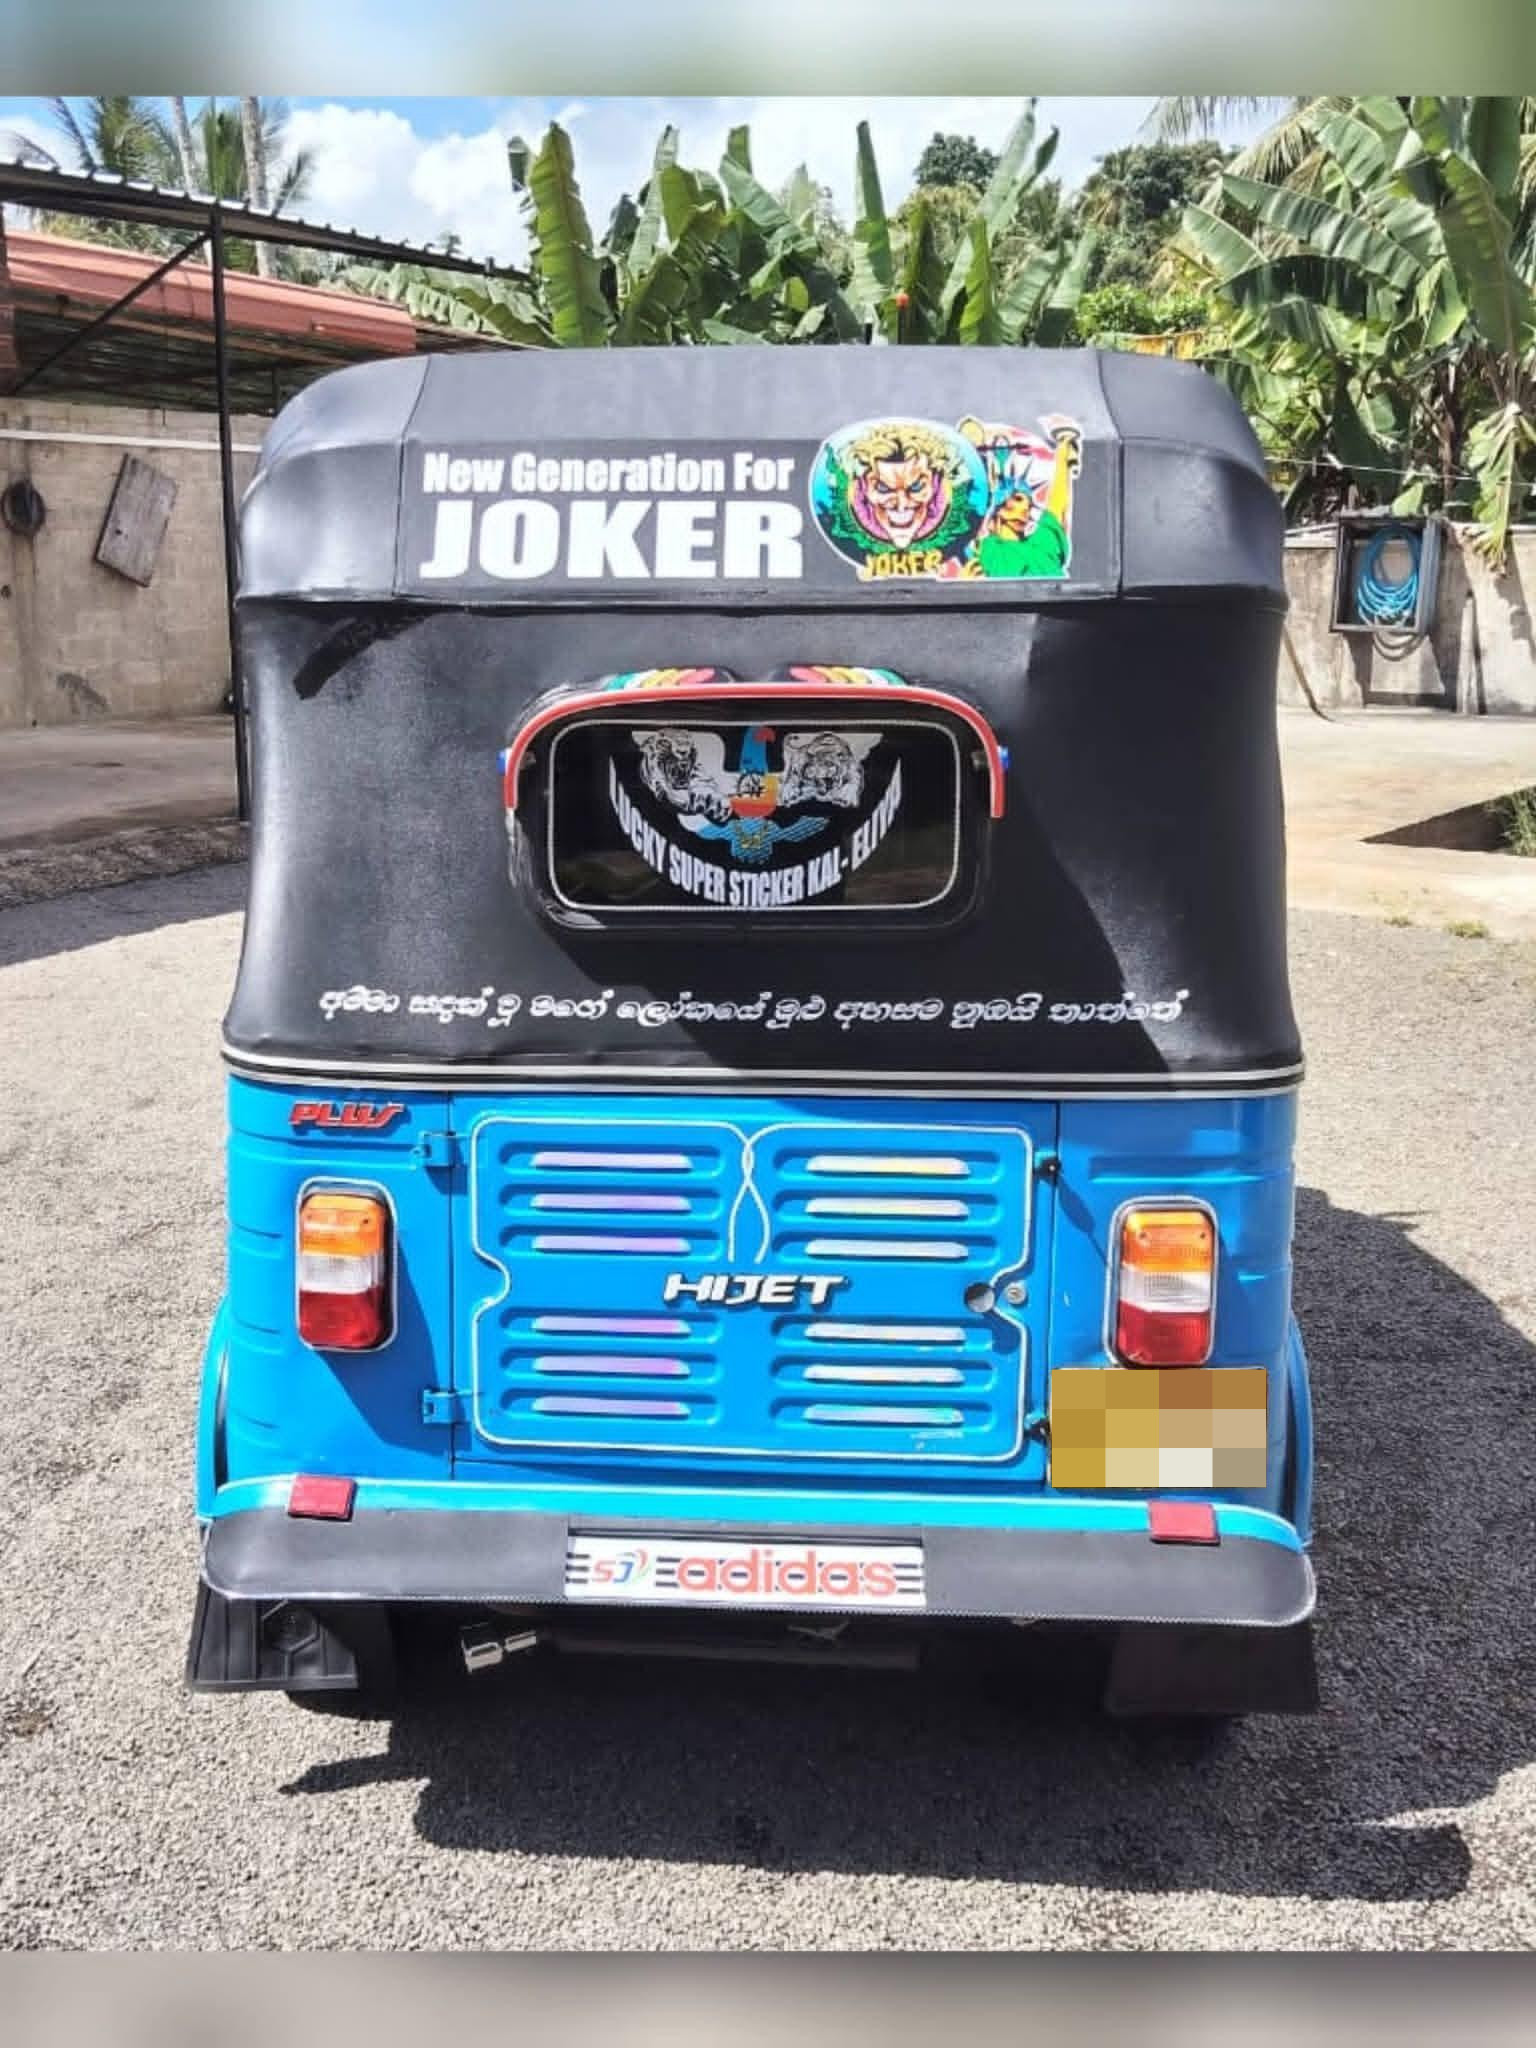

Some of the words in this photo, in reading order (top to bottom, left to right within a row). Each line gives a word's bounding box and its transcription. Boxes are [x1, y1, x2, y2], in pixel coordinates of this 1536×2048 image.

[423, 452, 505, 493] New
[511, 452, 729, 493] Generation
[734, 453, 795, 491] For
[420, 499, 803, 579] JOKER
[864, 549, 943, 578] JOKER
[608, 754, 667, 874] LUCKY
[668, 843, 726, 904] SUPER
[729, 864, 805, 908] STICKER
[319, 985, 400, 1021] අම්මා
[530, 989, 615, 1020] මගේ
[616, 991, 773, 1027] ලෝකයේ
[833, 997, 945, 1031] අහසම
[1048, 989, 1190, 1024] තාත්තේ
[288, 1099, 405, 1128] PLUS
[663, 1272, 846, 1306] HIJET
[676, 1549, 898, 1596] adidas
